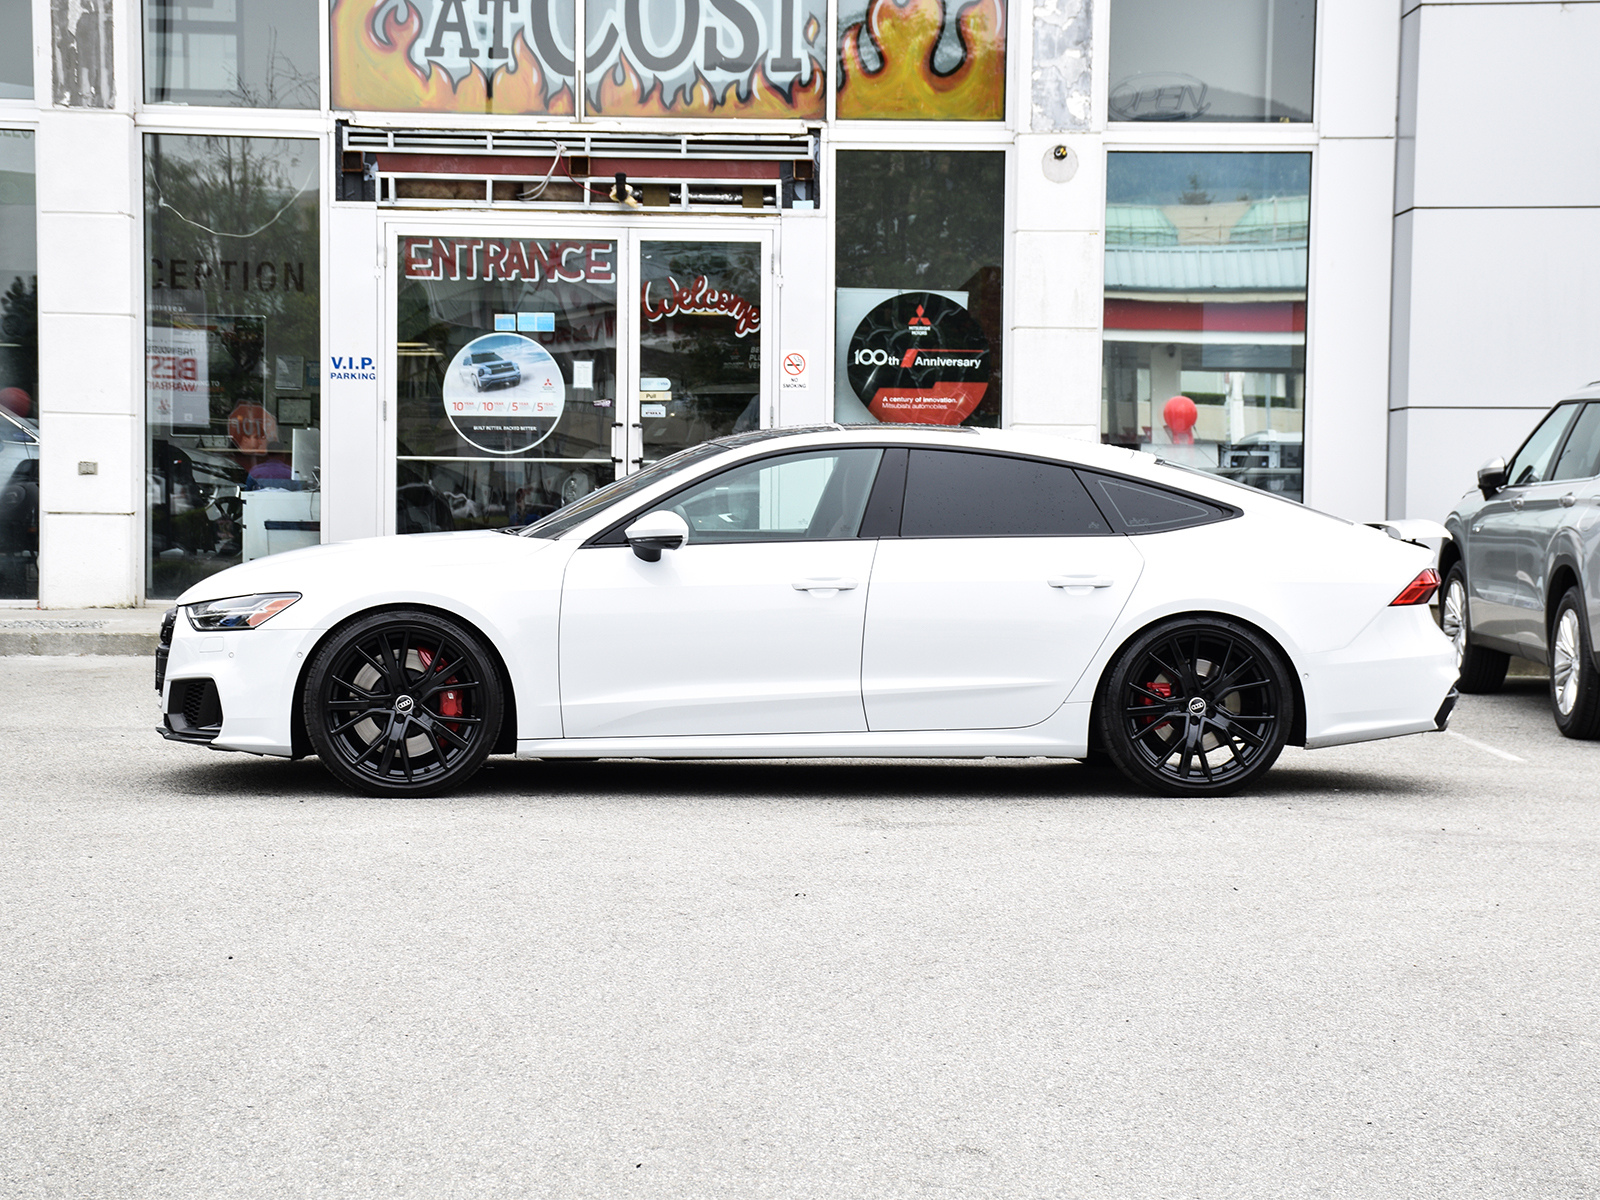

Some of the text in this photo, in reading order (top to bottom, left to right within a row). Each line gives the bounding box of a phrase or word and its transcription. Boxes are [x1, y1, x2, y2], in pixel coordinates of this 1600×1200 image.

[1110, 84, 1208, 112] OPEN
[404, 237, 616, 284] ENTRANCE
[641, 275, 761, 338] Welcome
[331, 356, 376, 369] V.I.P.
[854, 348, 982, 369] 100th Anniversary
[330, 372, 376, 380] PARKING
[452, 402, 464, 411] 10
[482, 402, 494, 411] 10
[511, 402, 519, 412] 5
[537, 402, 544, 412] 5
